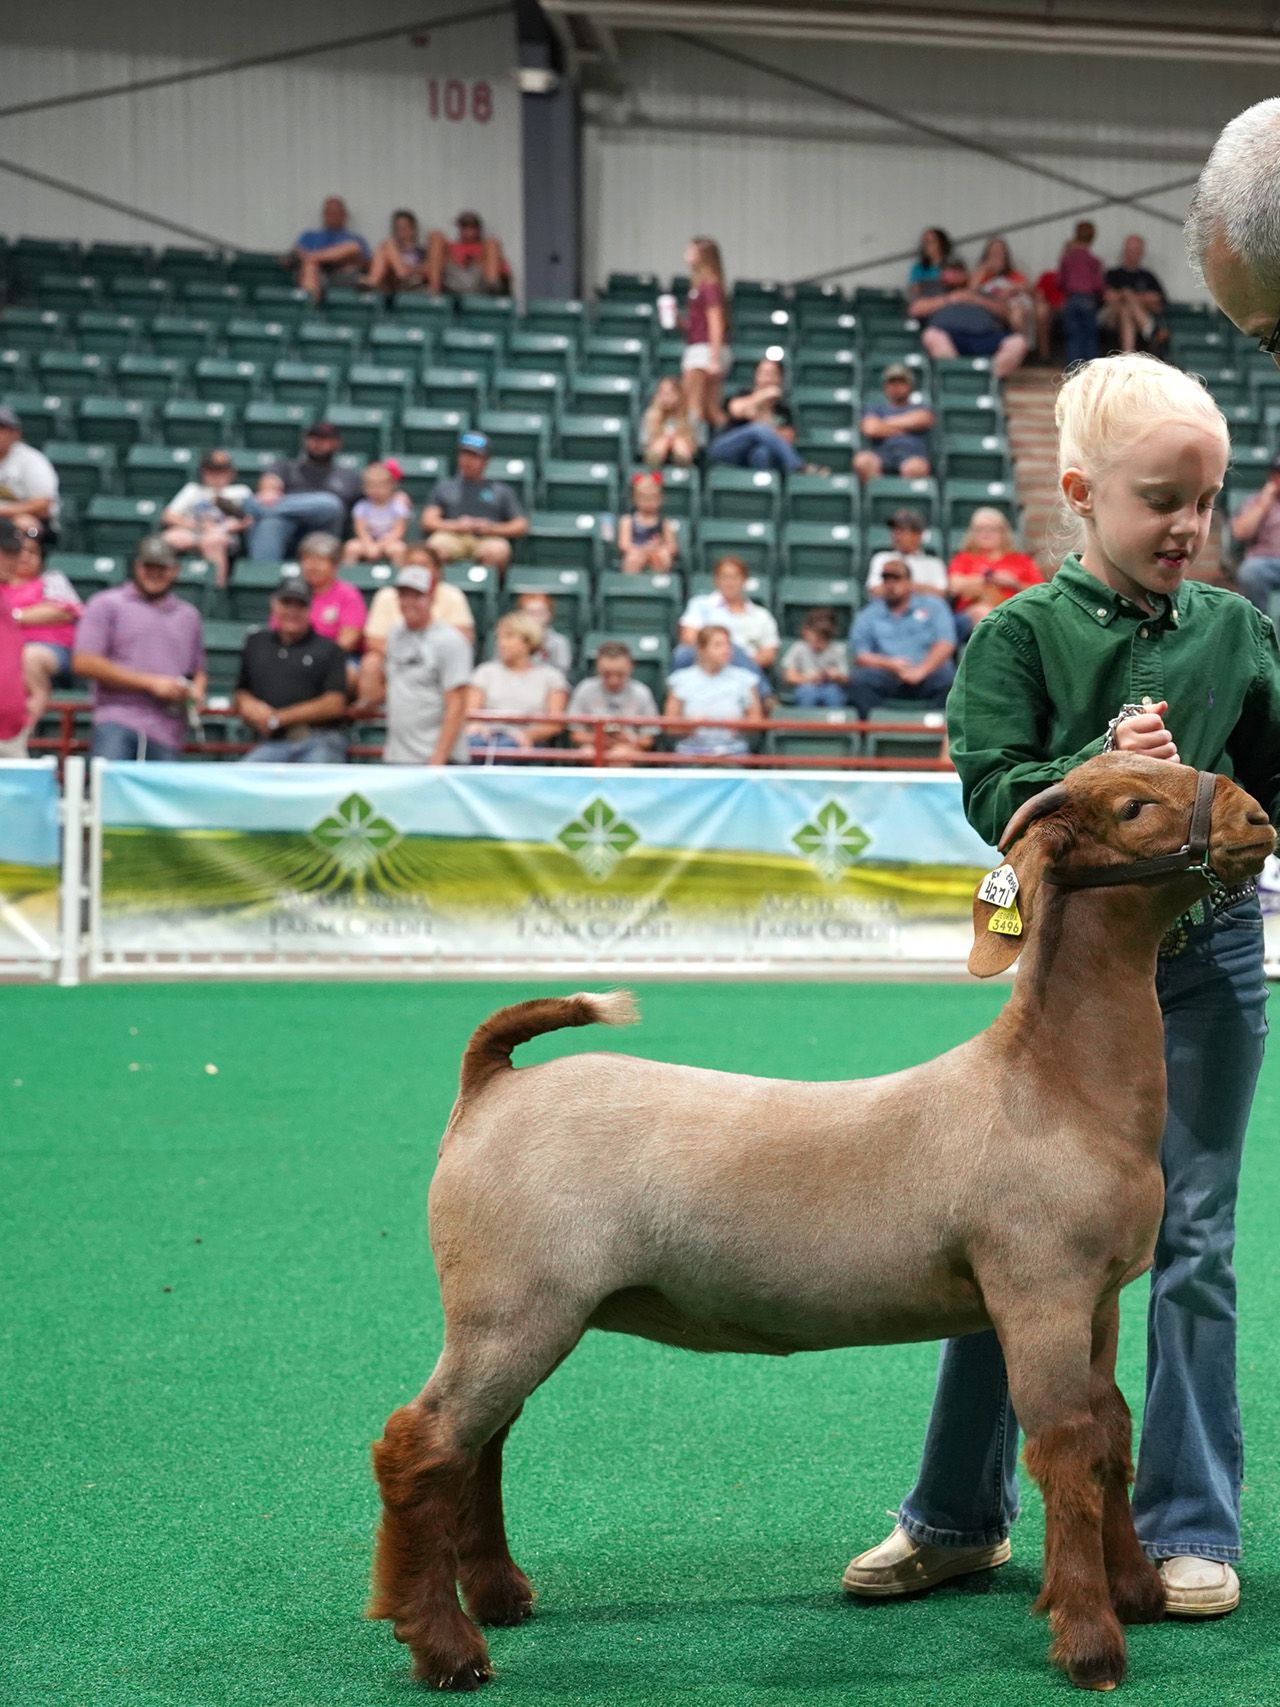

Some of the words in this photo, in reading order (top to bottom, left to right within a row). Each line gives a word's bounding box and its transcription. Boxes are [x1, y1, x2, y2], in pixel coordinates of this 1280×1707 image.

[428, 78, 493, 124] 108
[985, 881, 1010, 905] 4271
[992, 919, 1019, 933] 3496
